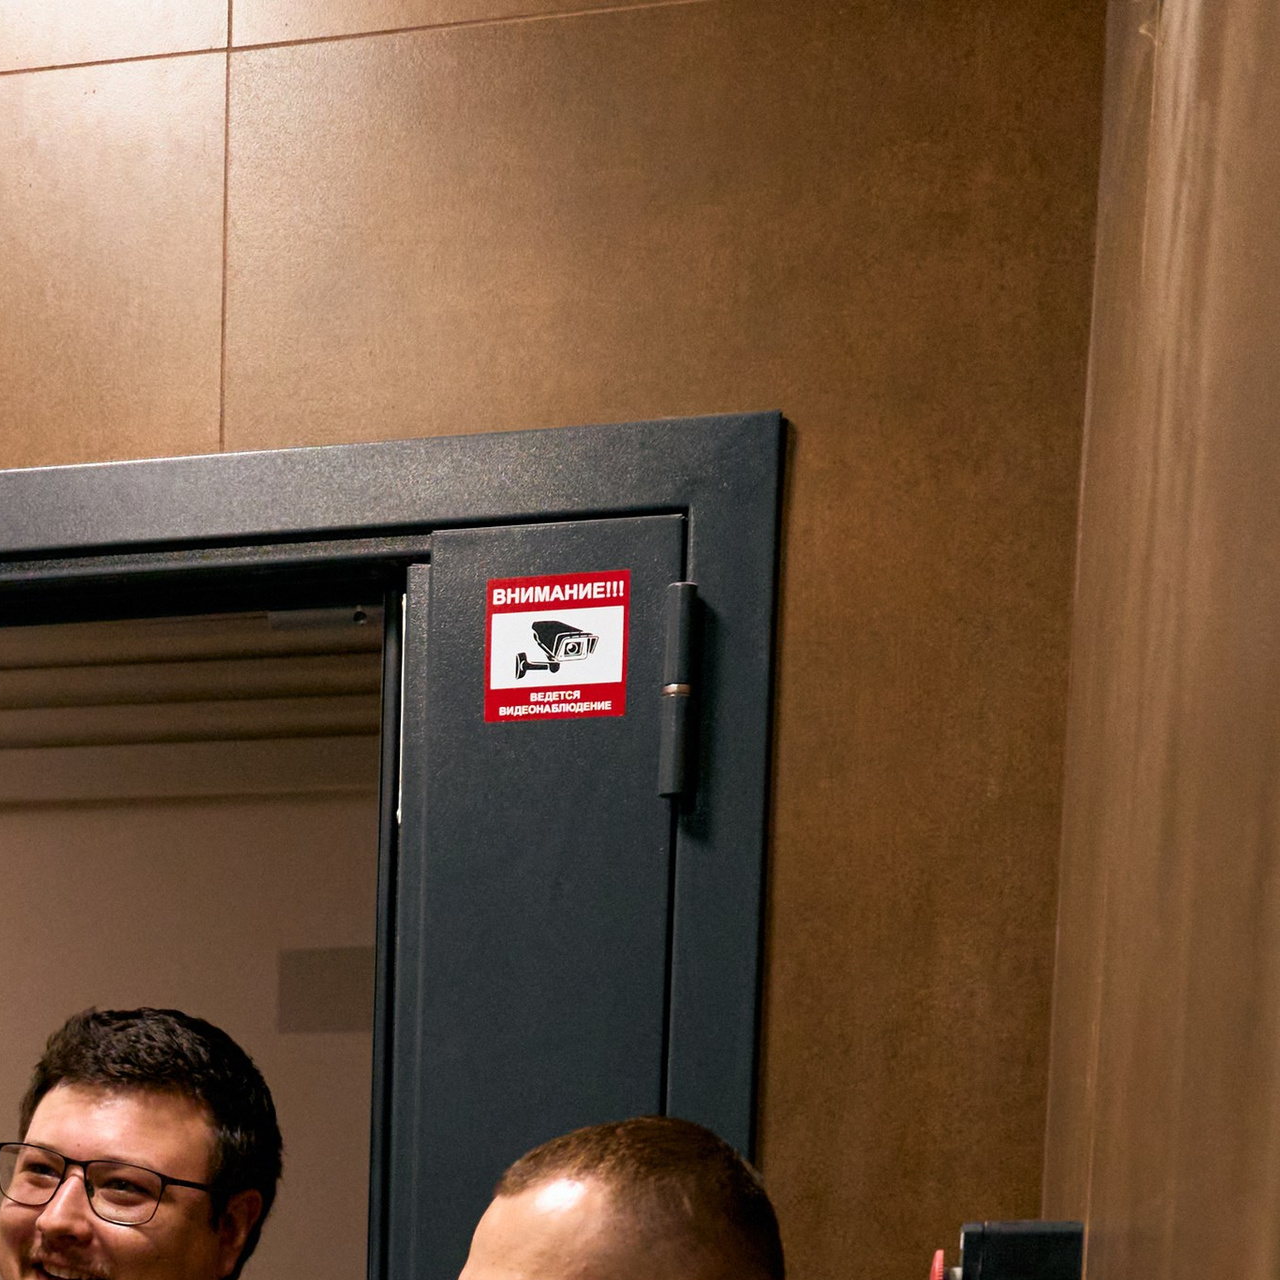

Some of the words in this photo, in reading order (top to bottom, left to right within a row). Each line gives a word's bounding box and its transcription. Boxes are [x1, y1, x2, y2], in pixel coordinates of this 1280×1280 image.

[492, 580, 624, 605] ВНИМАНИЕ!!!
[529, 690, 581, 702] ВЕДЕТСЯ
[498, 700, 612, 716] ВИДЕОНАБЛЮДЕНИЕ
